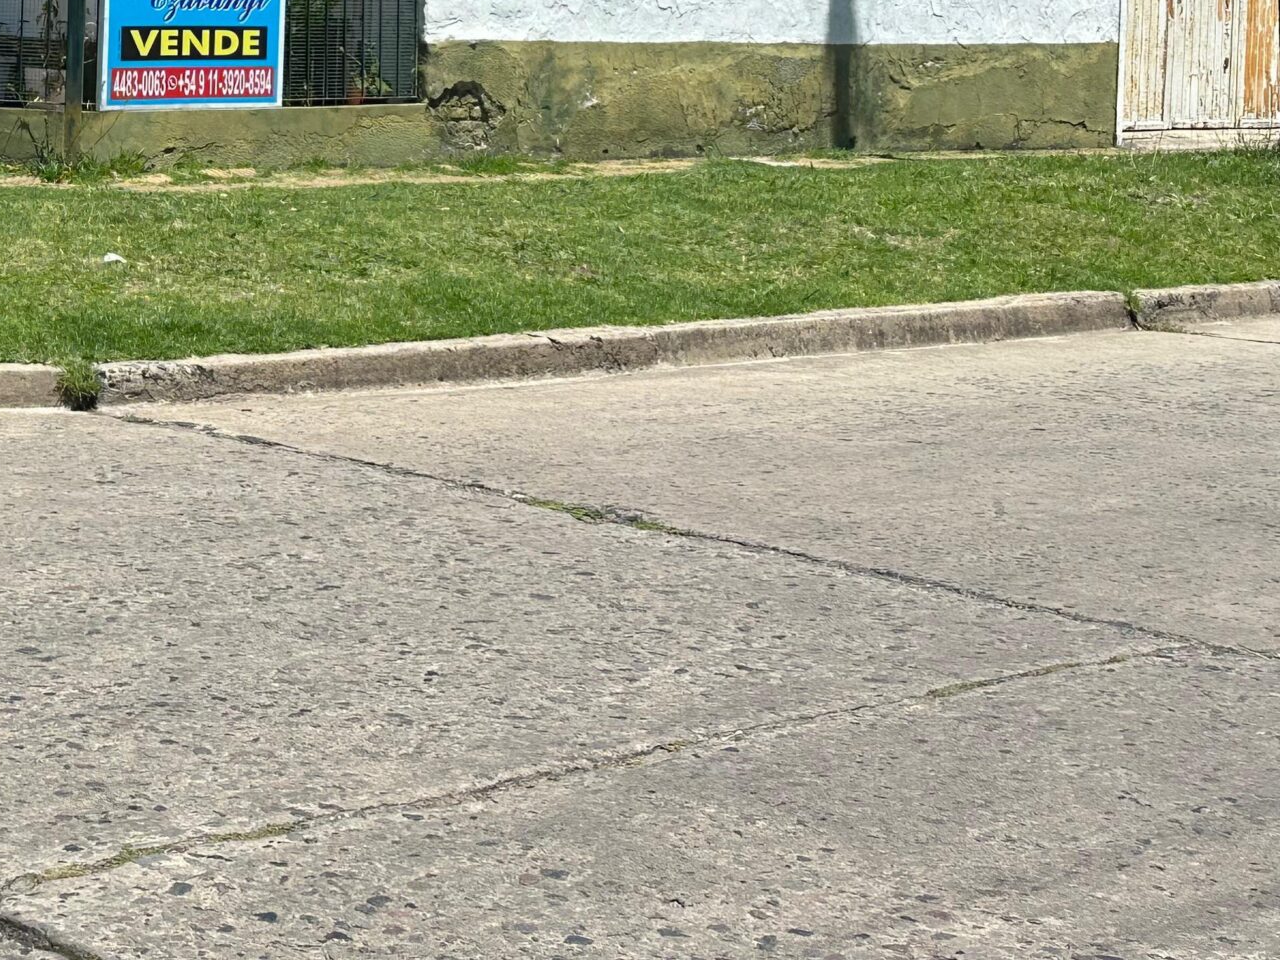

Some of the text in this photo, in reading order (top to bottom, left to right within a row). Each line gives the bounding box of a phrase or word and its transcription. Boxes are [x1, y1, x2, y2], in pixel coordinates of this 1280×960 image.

[130, 29, 261, 56] VENDE
[113, 69, 167, 97] 4483-0063
[178, 69, 197, 96] +54
[198, 69, 205, 96] 9
